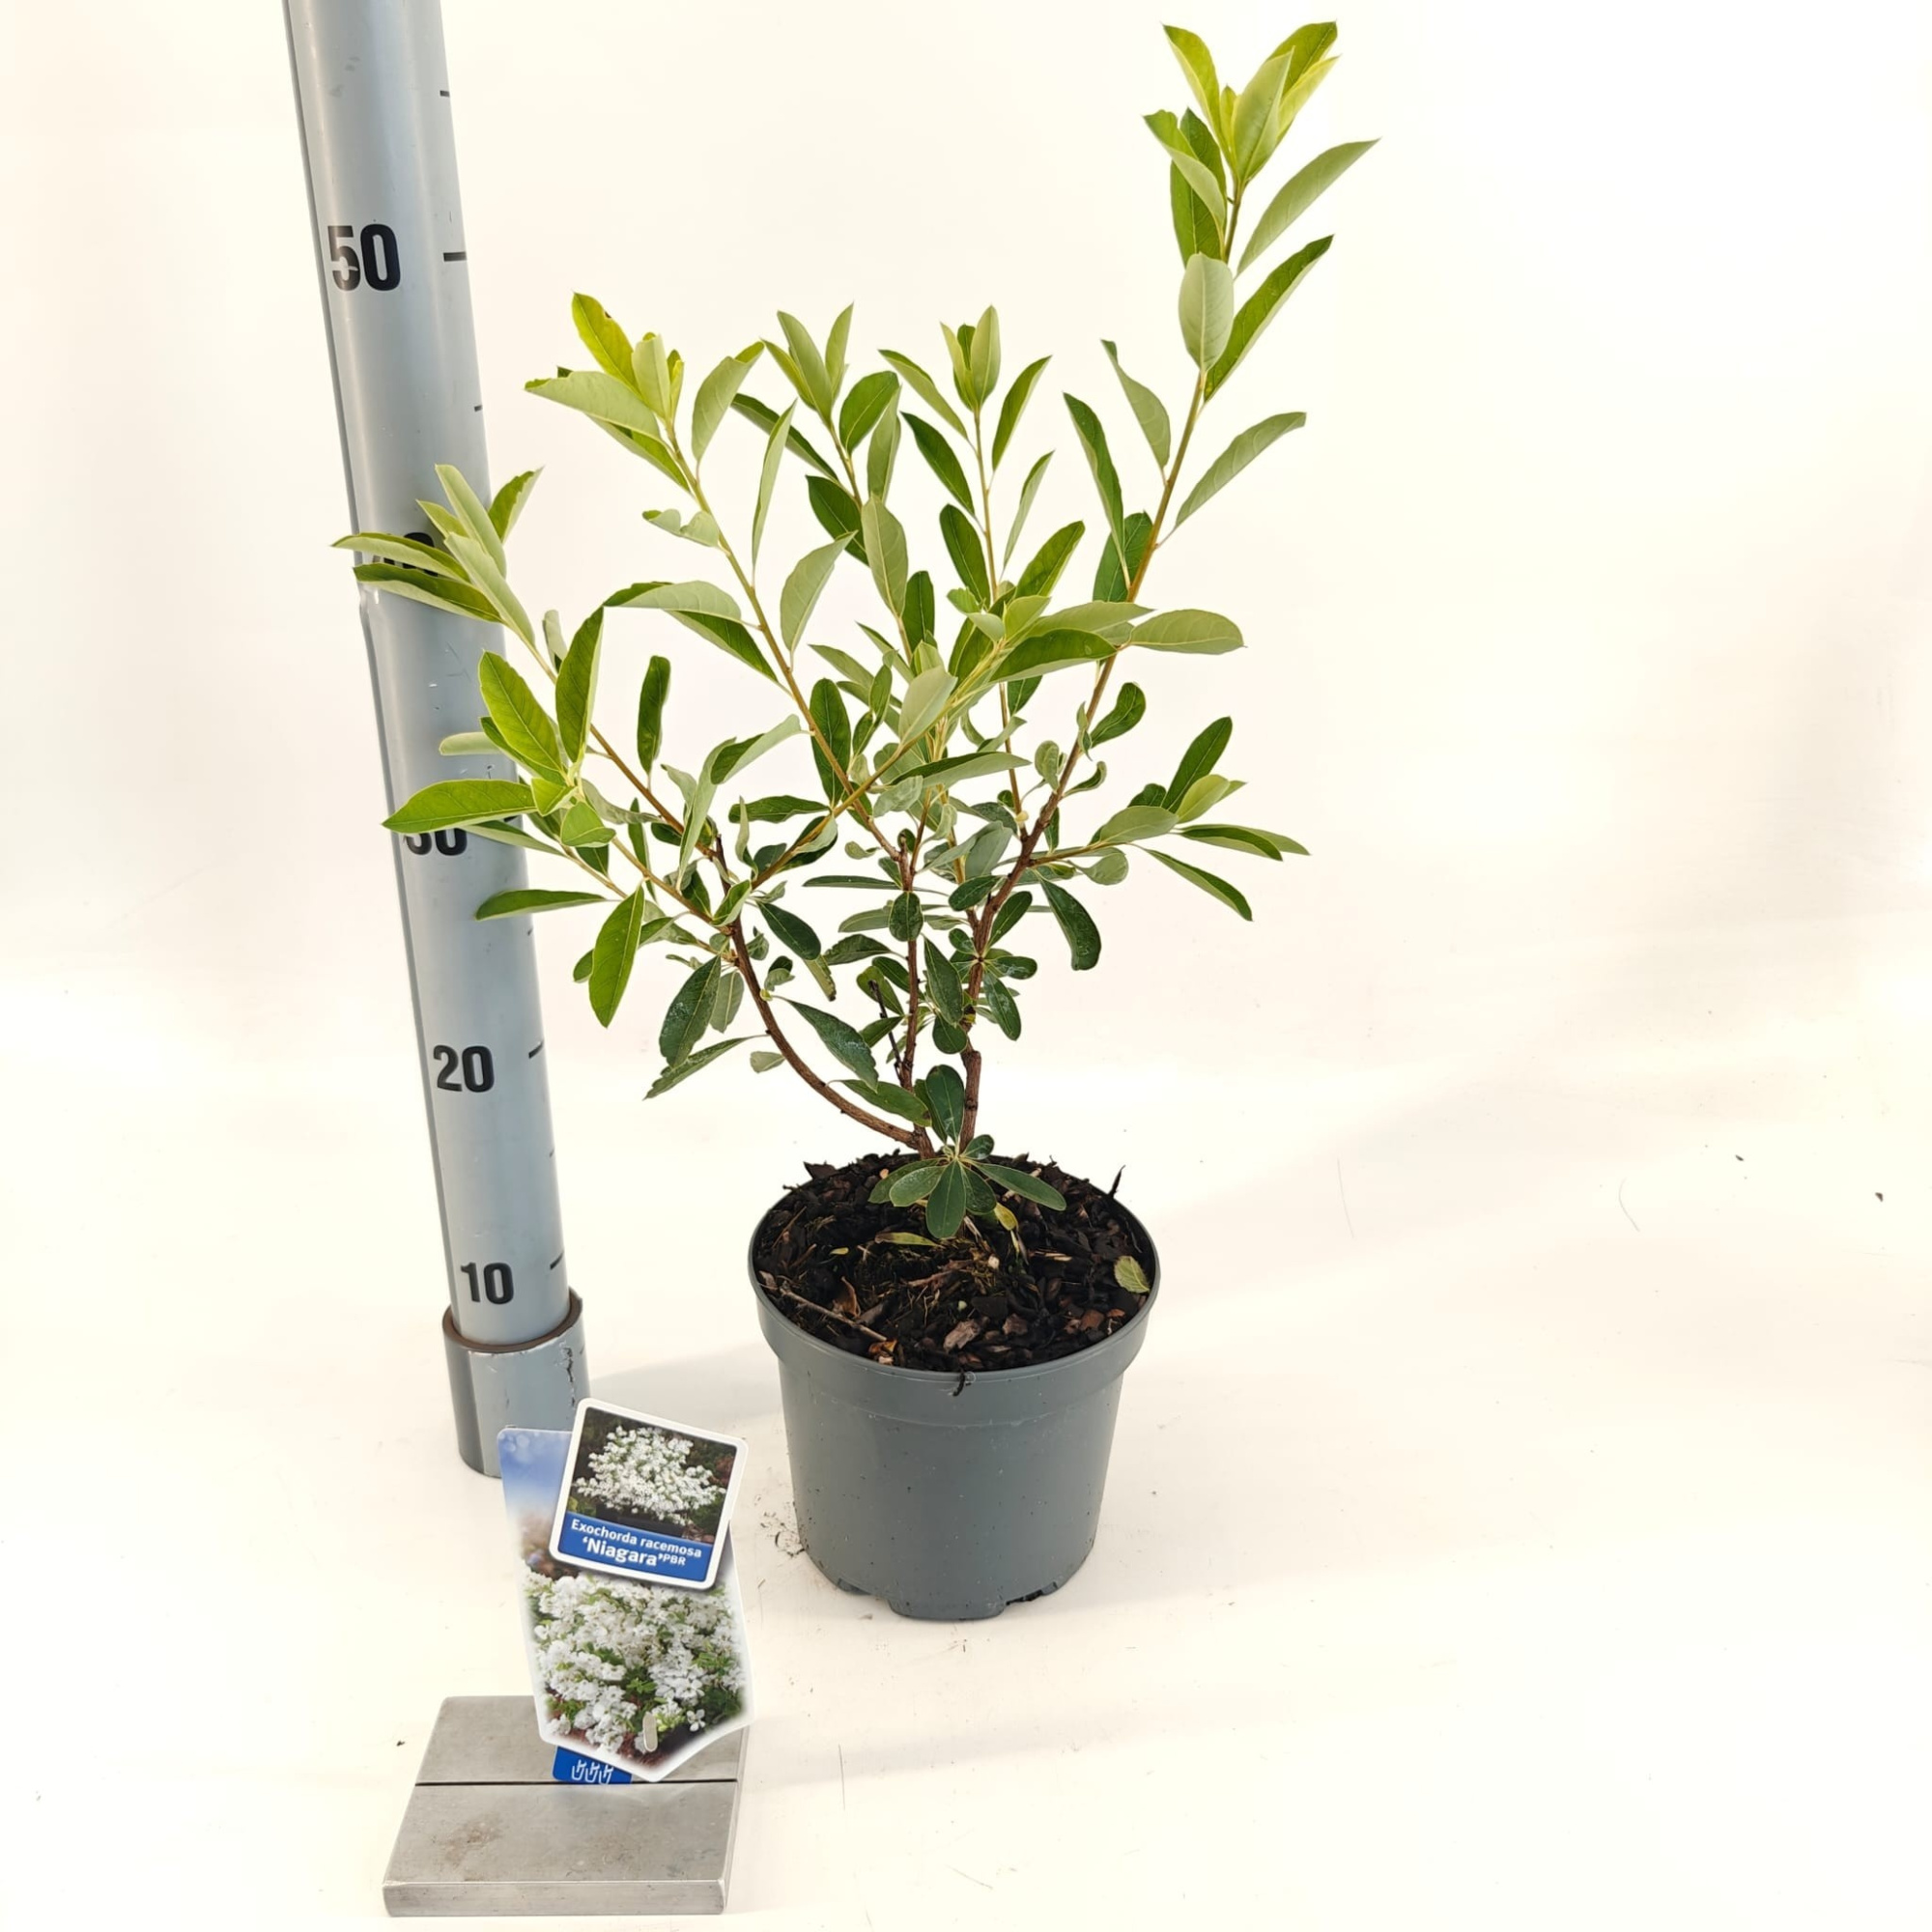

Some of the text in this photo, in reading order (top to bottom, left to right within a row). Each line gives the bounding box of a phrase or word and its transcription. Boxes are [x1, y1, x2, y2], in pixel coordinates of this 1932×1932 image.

[327, 223, 401, 291] 50
[433, 1044, 495, 1093] 20
[460, 1262, 514, 1304] 10
[571, 1518, 701, 1558] Exochorda racemosa
